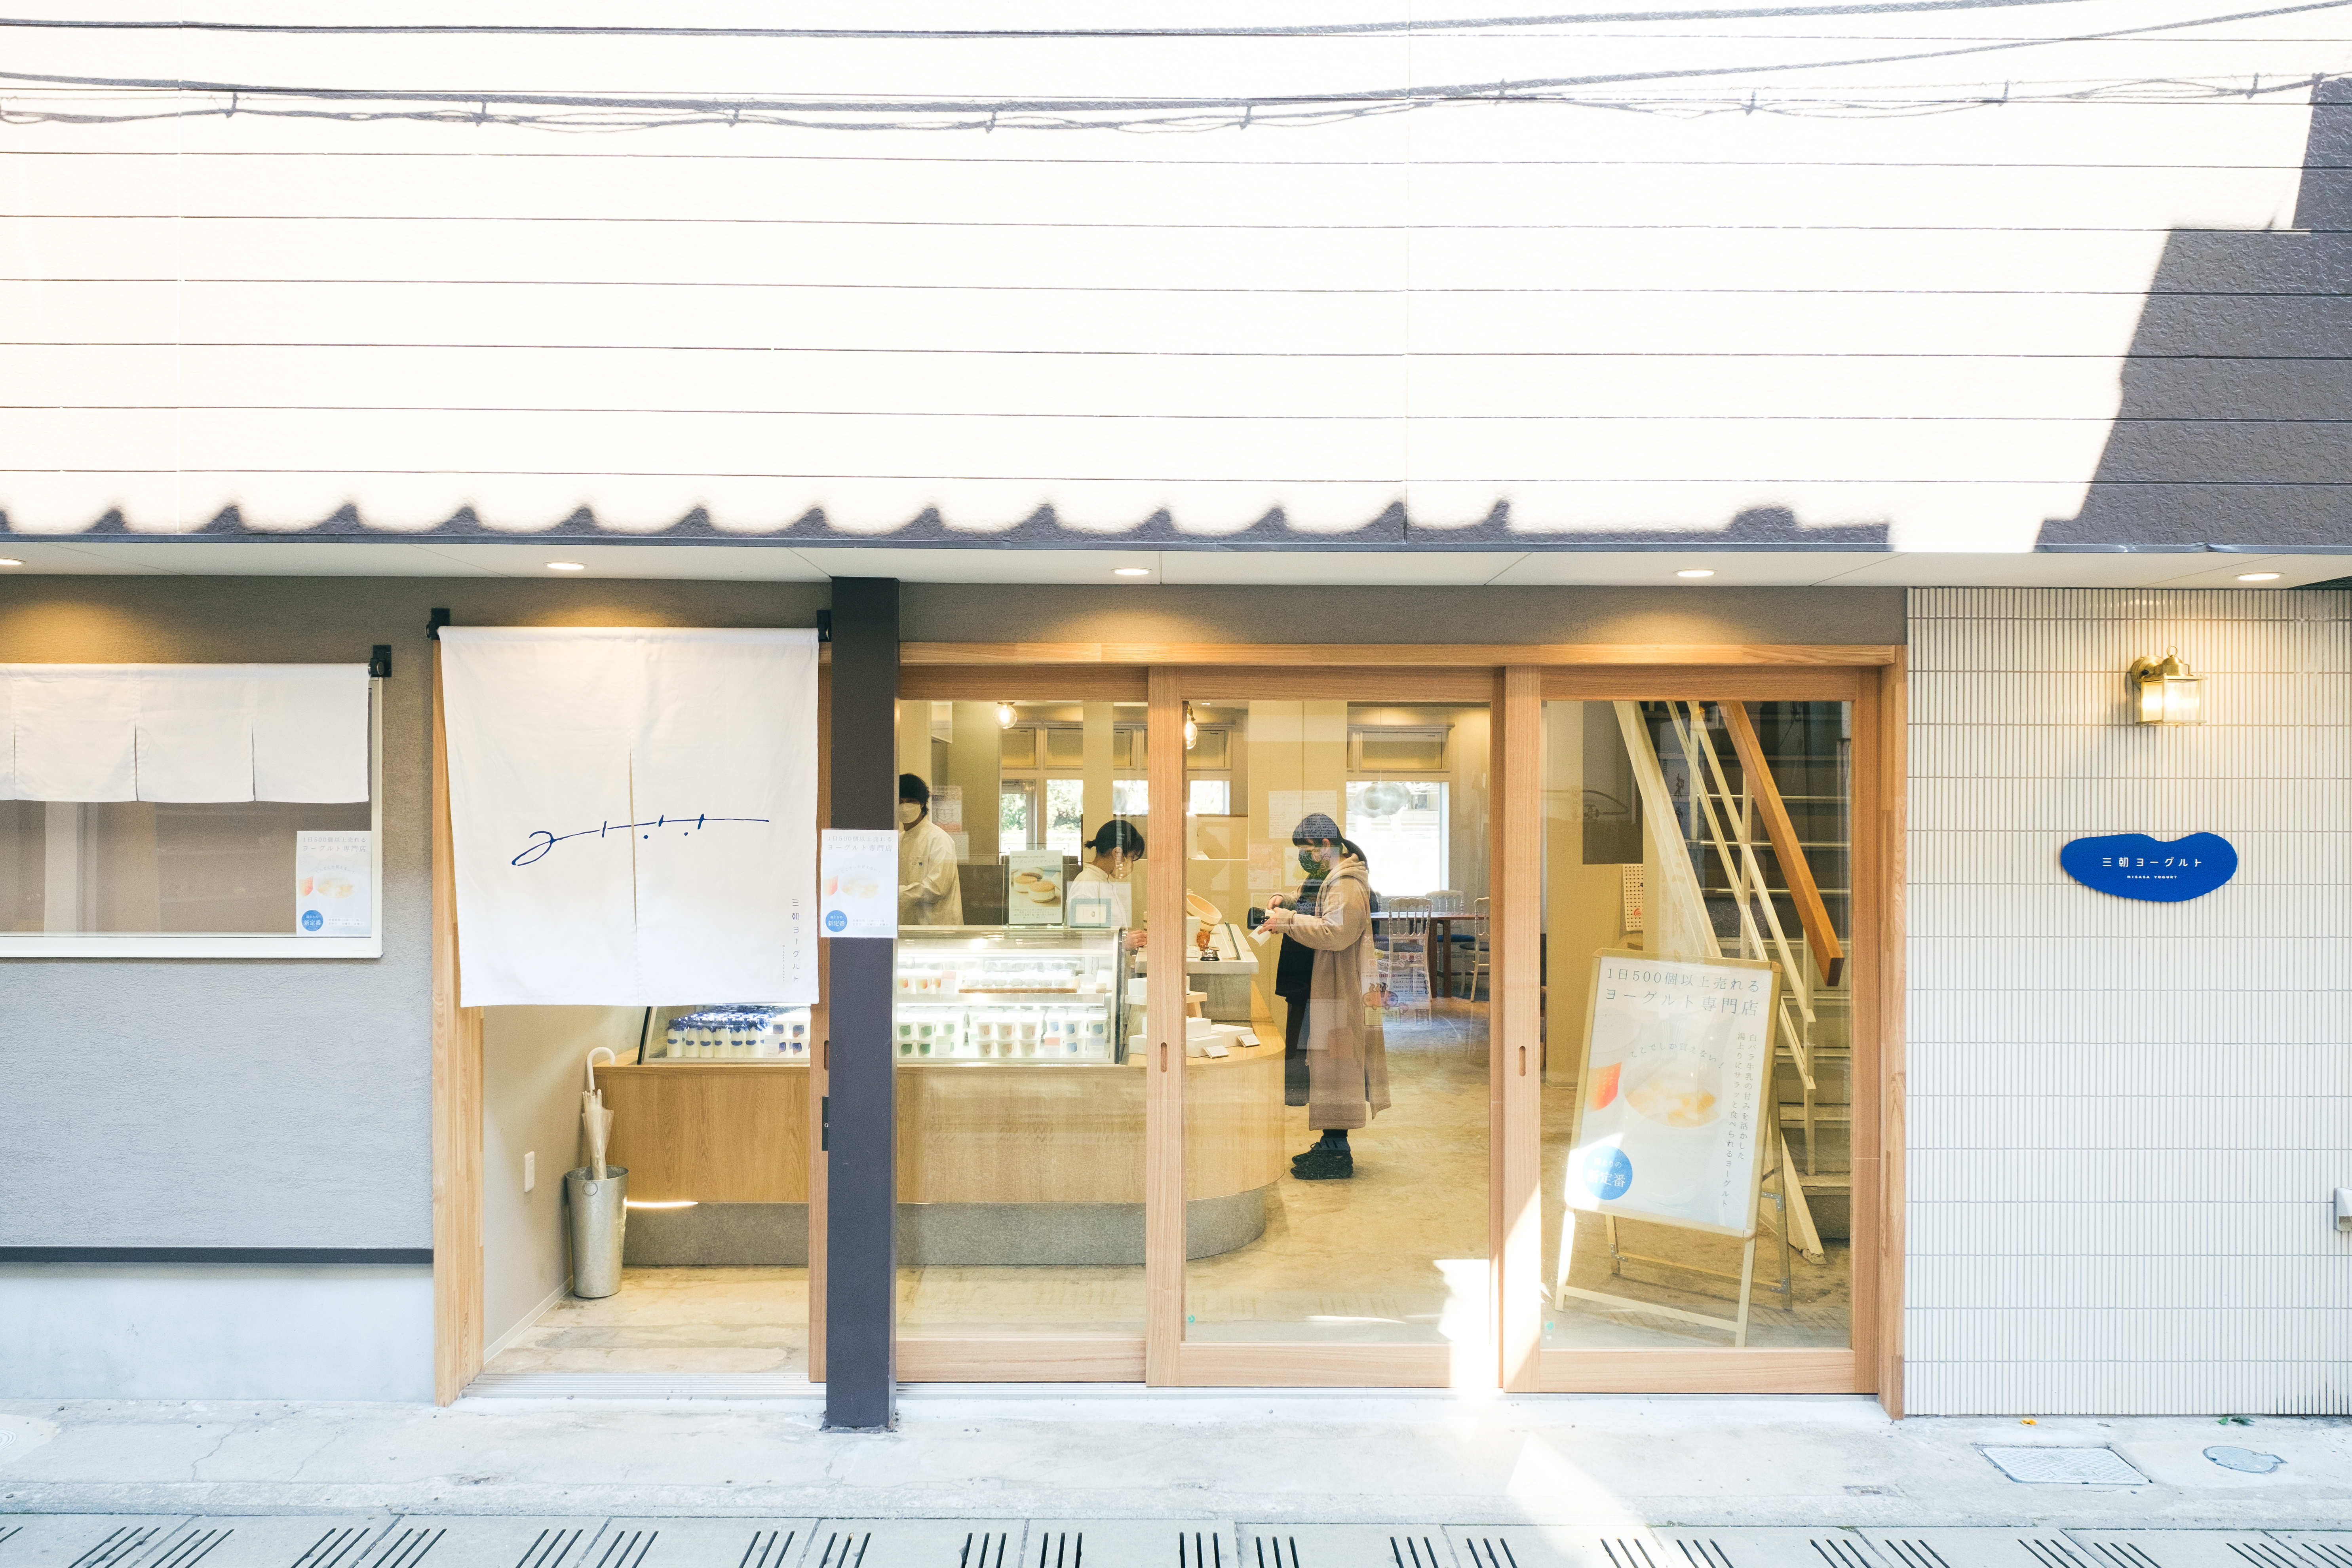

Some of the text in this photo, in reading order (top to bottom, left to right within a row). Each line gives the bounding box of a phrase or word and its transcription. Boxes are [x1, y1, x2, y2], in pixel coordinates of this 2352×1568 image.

[2102, 857, 2202, 867] 三朝ヨーグルト
[1607, 967, 1759, 992] 1日500個以上売れる
[1605, 988, 1758, 1017] ヨーグルト専門店
[1738, 1034, 1757, 1159] 白バラ牛乳の甘みを活かした
[1721, 1032, 1745, 1207] 湯上りにサラッと食べられるヨーグルト
[1586, 1168, 1626, 1188] 新定番
